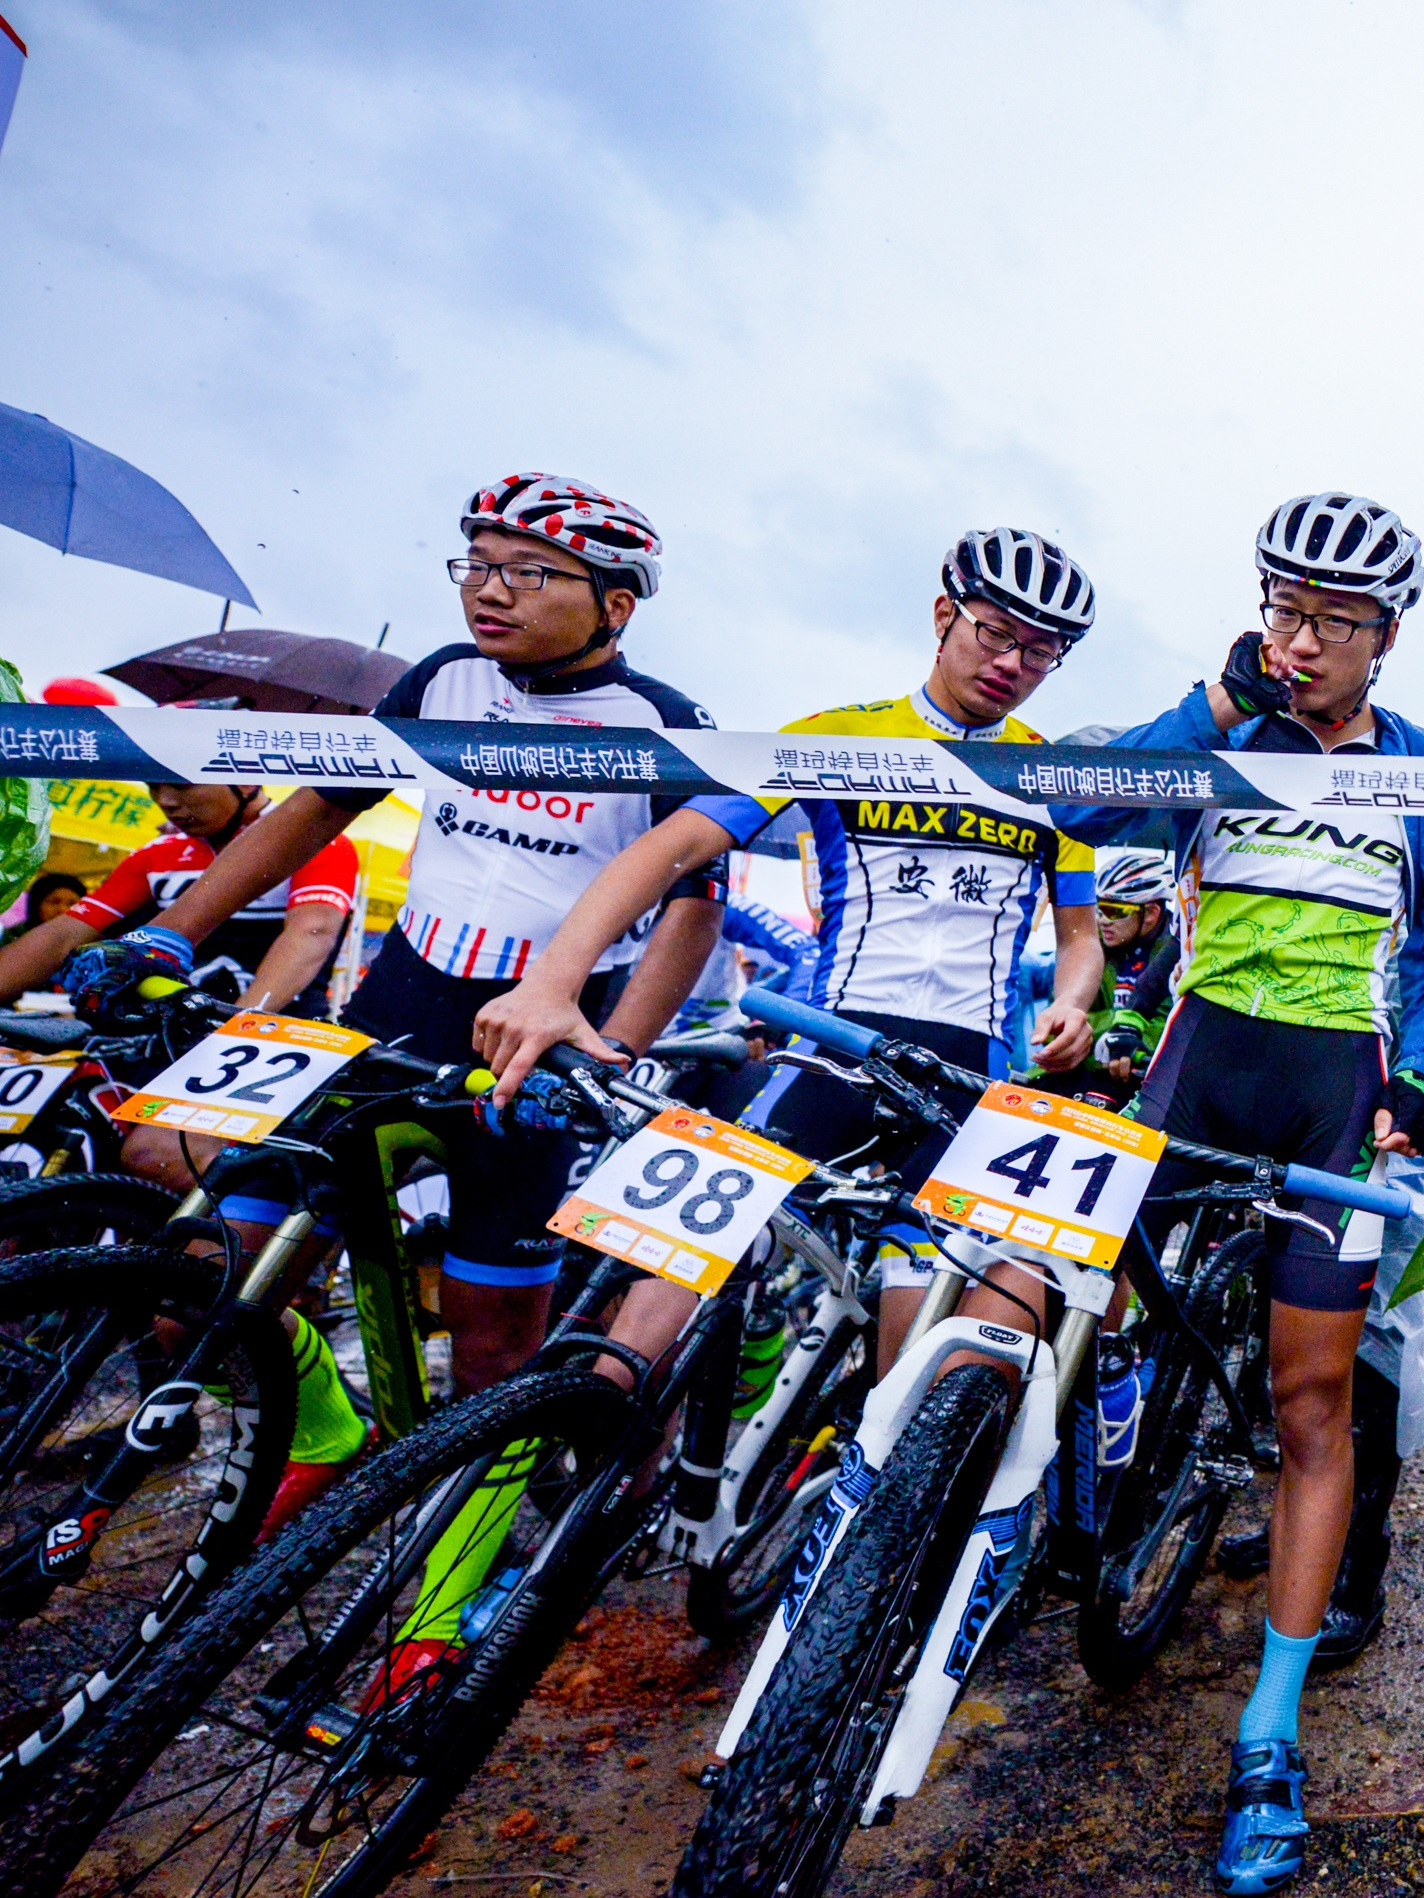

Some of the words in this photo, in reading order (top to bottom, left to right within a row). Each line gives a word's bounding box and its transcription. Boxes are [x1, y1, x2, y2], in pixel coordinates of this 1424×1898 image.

[462, 819, 579, 856] CAMP
[858, 801, 945, 834] MAX
[956, 810, 1037, 853] ZERO
[1213, 815, 1404, 866] KUNG
[185, 1044, 311, 1104] 32
[623, 1148, 754, 1235] 98
[985, 1133, 1118, 1217] 41
[1075, 1400, 1096, 1533] MERIDA
